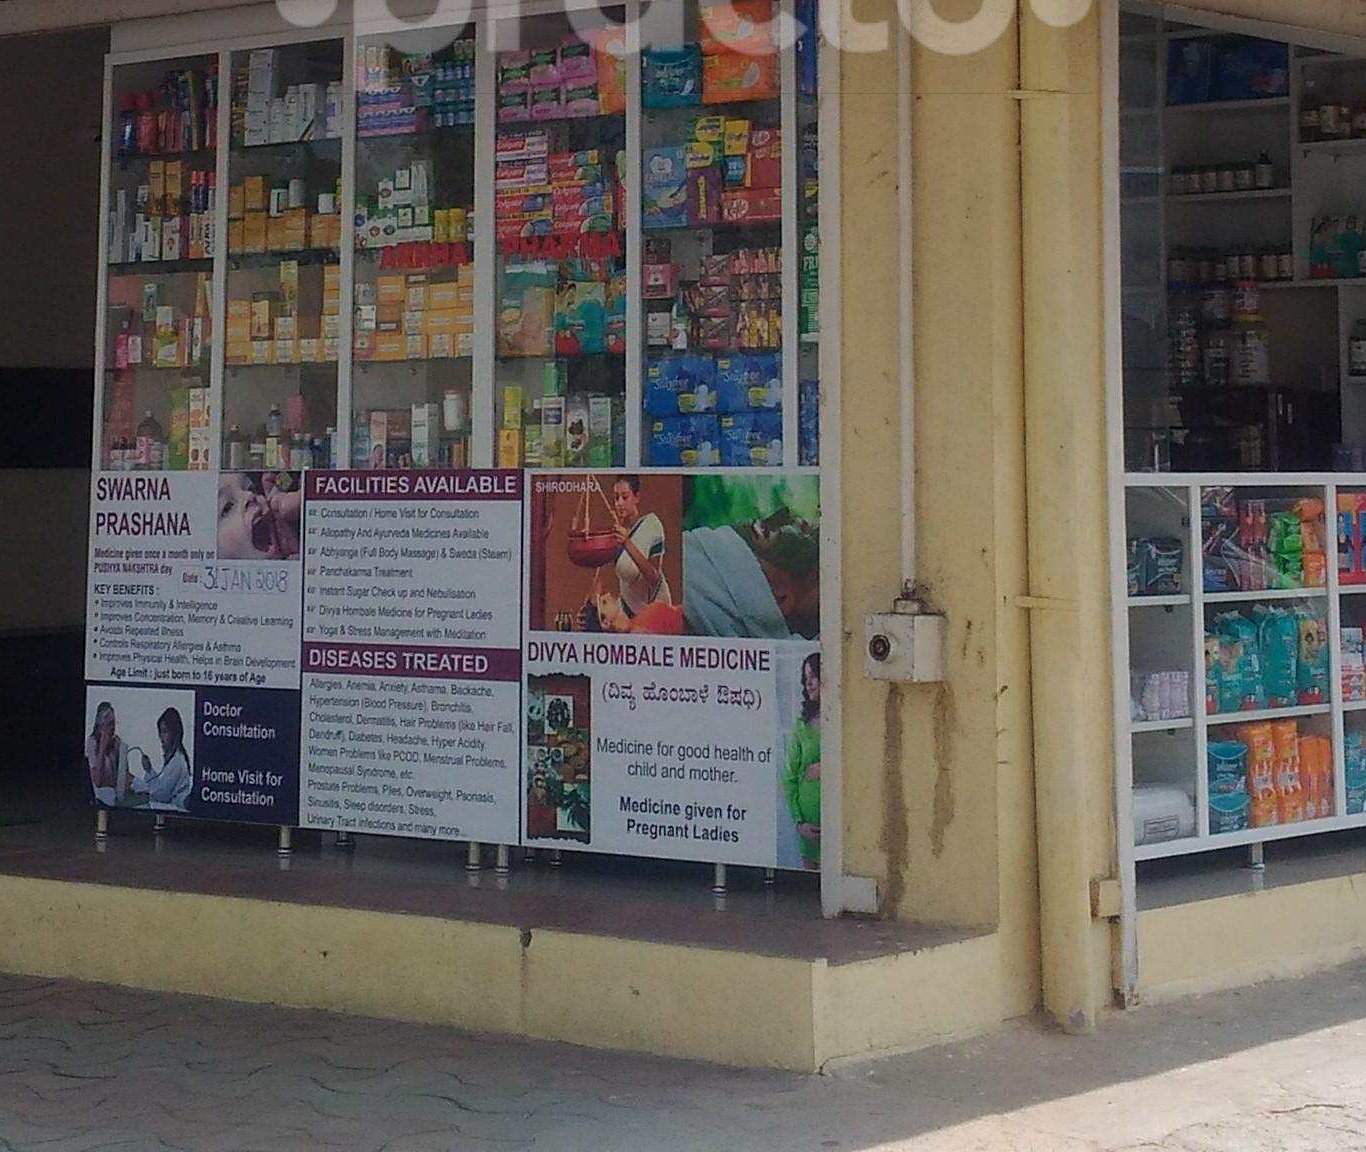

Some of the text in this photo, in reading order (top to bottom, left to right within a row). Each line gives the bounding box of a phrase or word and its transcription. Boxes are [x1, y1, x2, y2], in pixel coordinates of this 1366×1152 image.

[97, 477, 171, 502] SWARNA
[316, 476, 517, 494] FACILITIES AVAILABLE
[535, 481, 601, 493] SHIRODHARA
[321, 508, 479, 519] Consultation Home Visit for Consultation
[95, 512, 192, 536] PRASHANA
[94, 584, 155, 595] KEY BENEFITS
[309, 649, 489, 673] DISEASES TREATED
[527, 641, 770, 671] DIVYA HOMBALE MEDICINE
[110, 666, 126, 677] Age
[128, 666, 148, 677] Limit
[171, 668, 190, 679] born
[214, 673, 237, 684] years
[249, 672, 266, 684] Age
[203, 701, 243, 718] Doctor
[203, 721, 276, 740] Consultation
[597, 737, 772, 763] Medicine for good health of
[202, 768, 283, 786] Home Visit for
[627, 761, 738, 783] child and mother.
[201, 787, 274, 807] Consultation
[619, 796, 747, 821] Medicine given for
[626, 818, 740, 843] Pregnant Ladies
